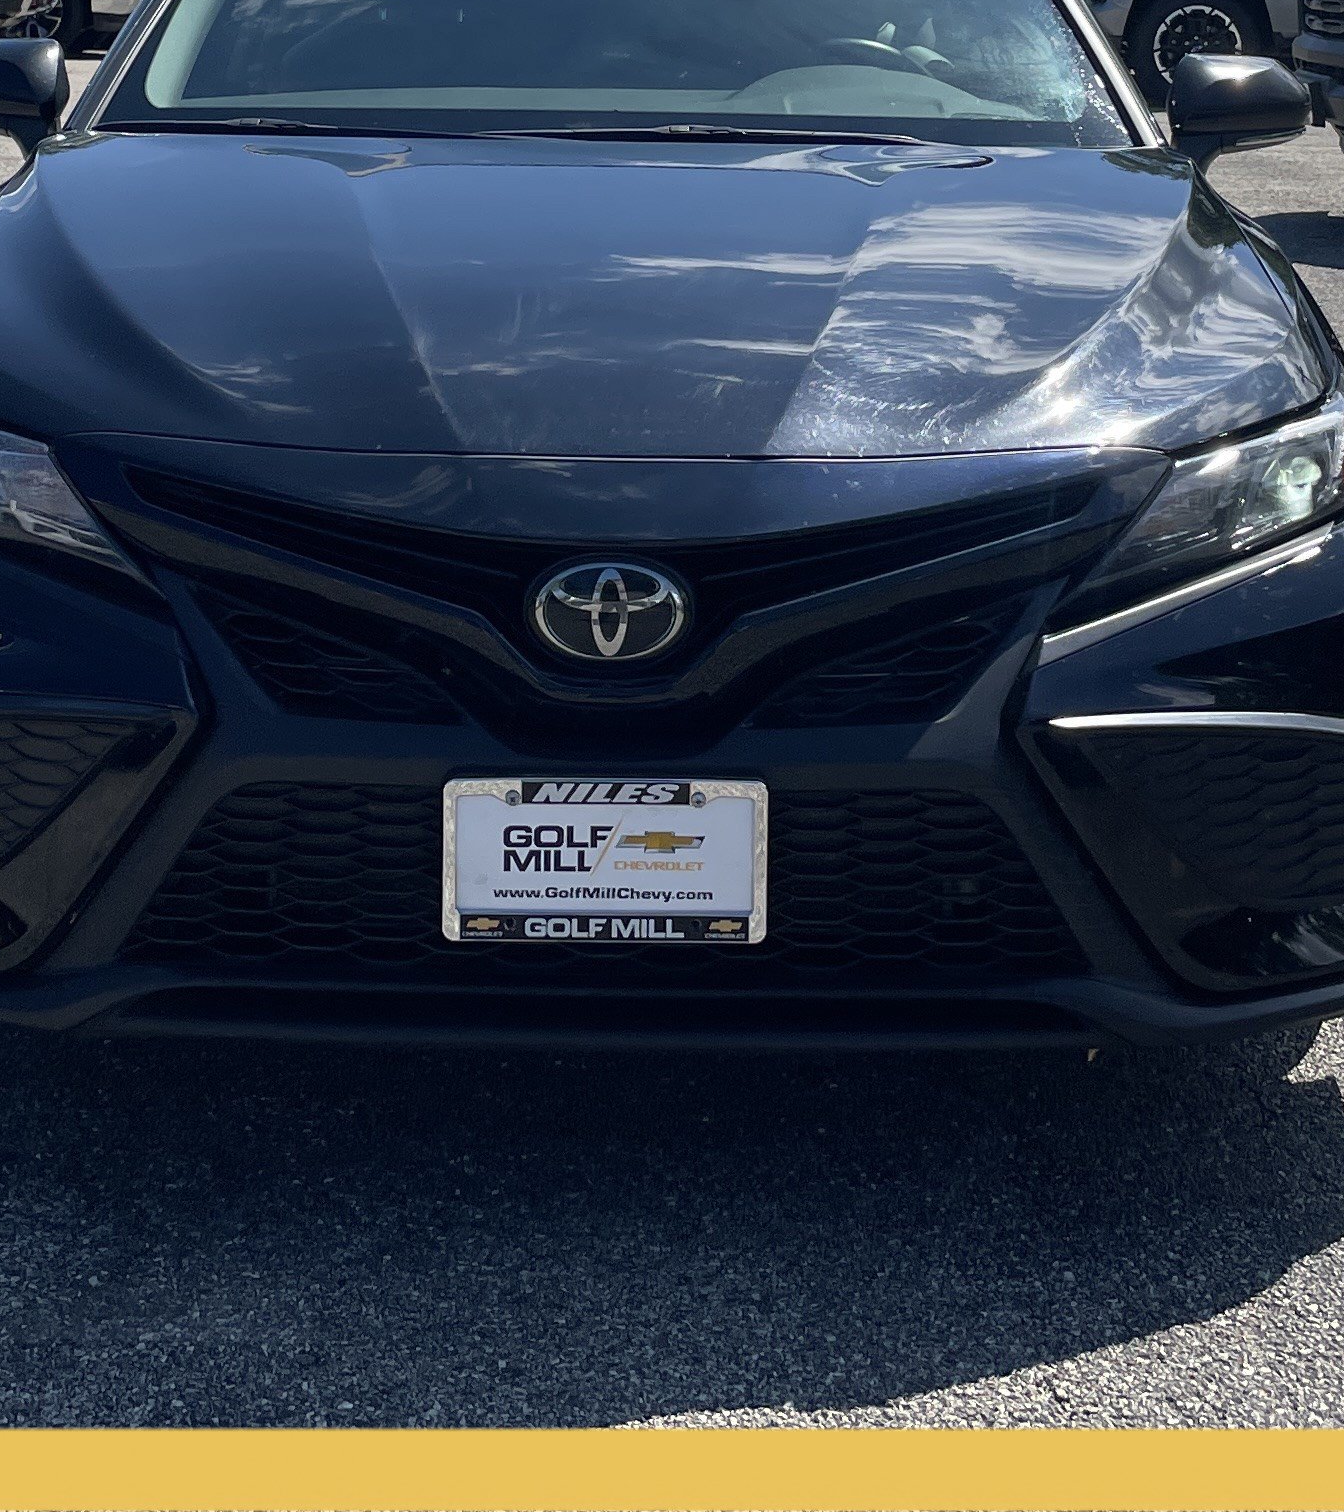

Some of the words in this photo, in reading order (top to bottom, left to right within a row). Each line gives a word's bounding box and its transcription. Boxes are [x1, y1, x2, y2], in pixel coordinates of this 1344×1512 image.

[531, 782, 681, 804] NILES
[503, 825, 615, 849] GOLF
[503, 849, 593, 872] MILL
[614, 860, 705, 872] CHEVROLET
[493, 886, 714, 903] www.GolfMillChevy.com
[524, 917, 607, 938] GOLF
[611, 918, 685, 938] MILL
